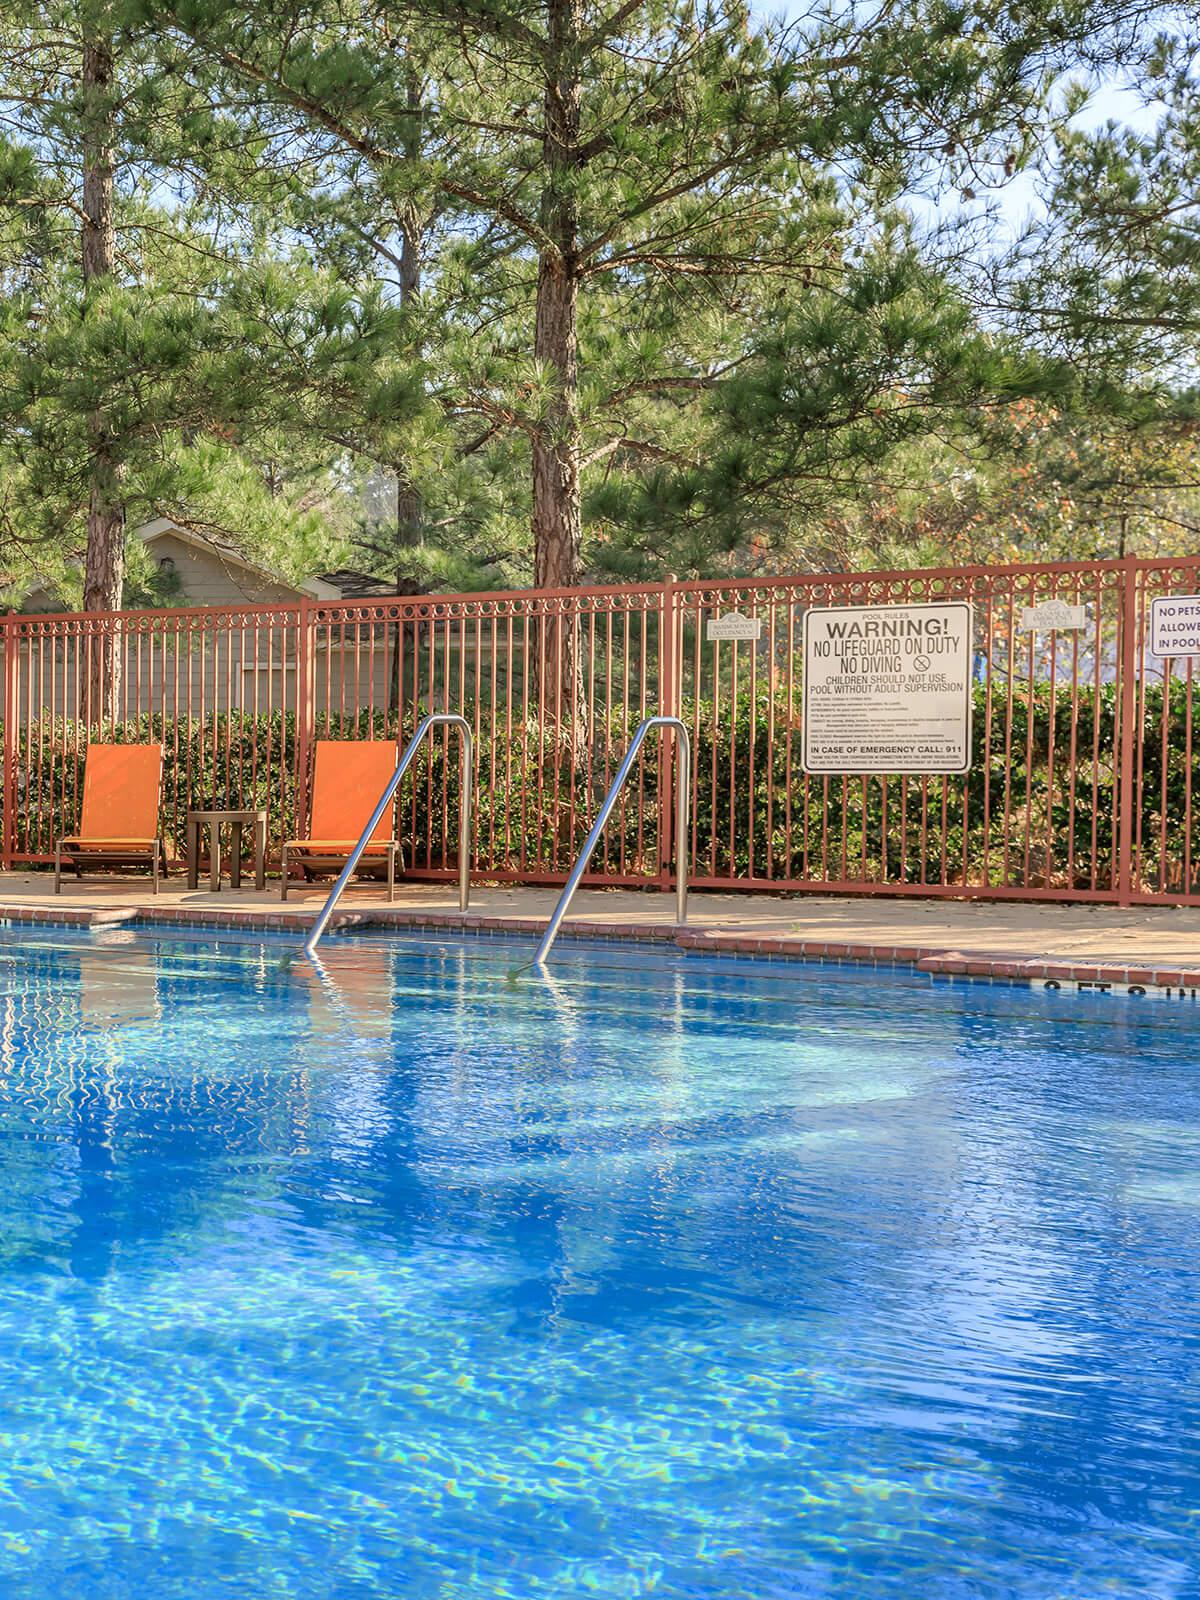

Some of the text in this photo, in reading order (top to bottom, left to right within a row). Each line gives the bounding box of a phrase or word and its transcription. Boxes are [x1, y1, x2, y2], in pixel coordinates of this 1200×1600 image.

[1159, 606, 1200, 617] NO PETS
[826, 618, 949, 638] WARNING!
[814, 636, 960, 657] NO LIFEGUARD ON DUTY
[1159, 639, 1170, 648] IN
[840, 655, 902, 674] NO DIVING
[825, 673, 946, 685] CHILDREN SHOULD NOT USE
[810, 682, 963, 695] POOL WITHOUT ADULT SUPERVISION
[810, 746, 819, 754] IN
[821, 746, 844, 754] CASE
[860, 745, 915, 753] EMERGENCY
[918, 745, 943, 753] CALL:
[946, 745, 961, 753] 911
